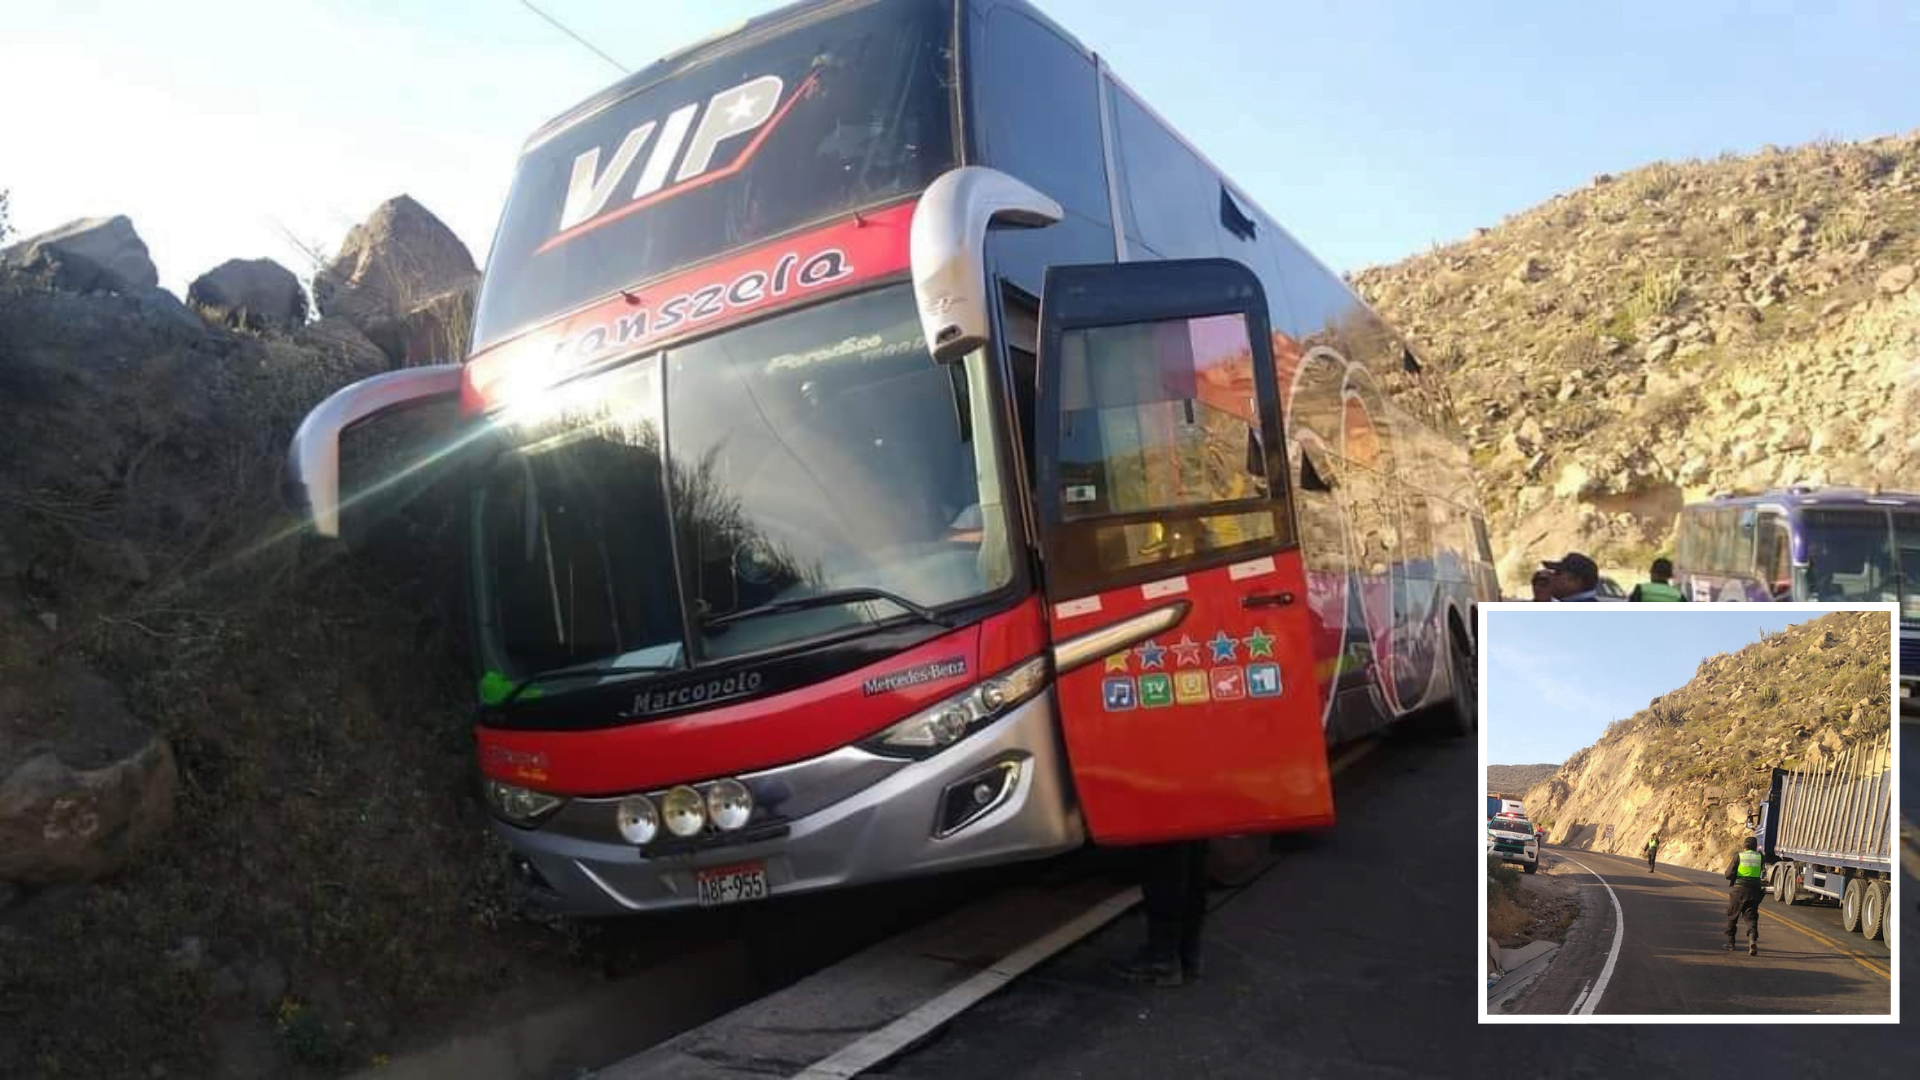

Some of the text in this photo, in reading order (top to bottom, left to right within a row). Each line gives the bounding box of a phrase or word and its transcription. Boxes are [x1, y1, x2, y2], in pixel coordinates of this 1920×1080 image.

[559, 75, 784, 231] VIP
[555, 248, 853, 355] anszela
[633, 671, 762, 712] Marcopolo
[863, 659, 966, 696] Mercedes-Benz
[1144, 682, 1165, 693] TV
